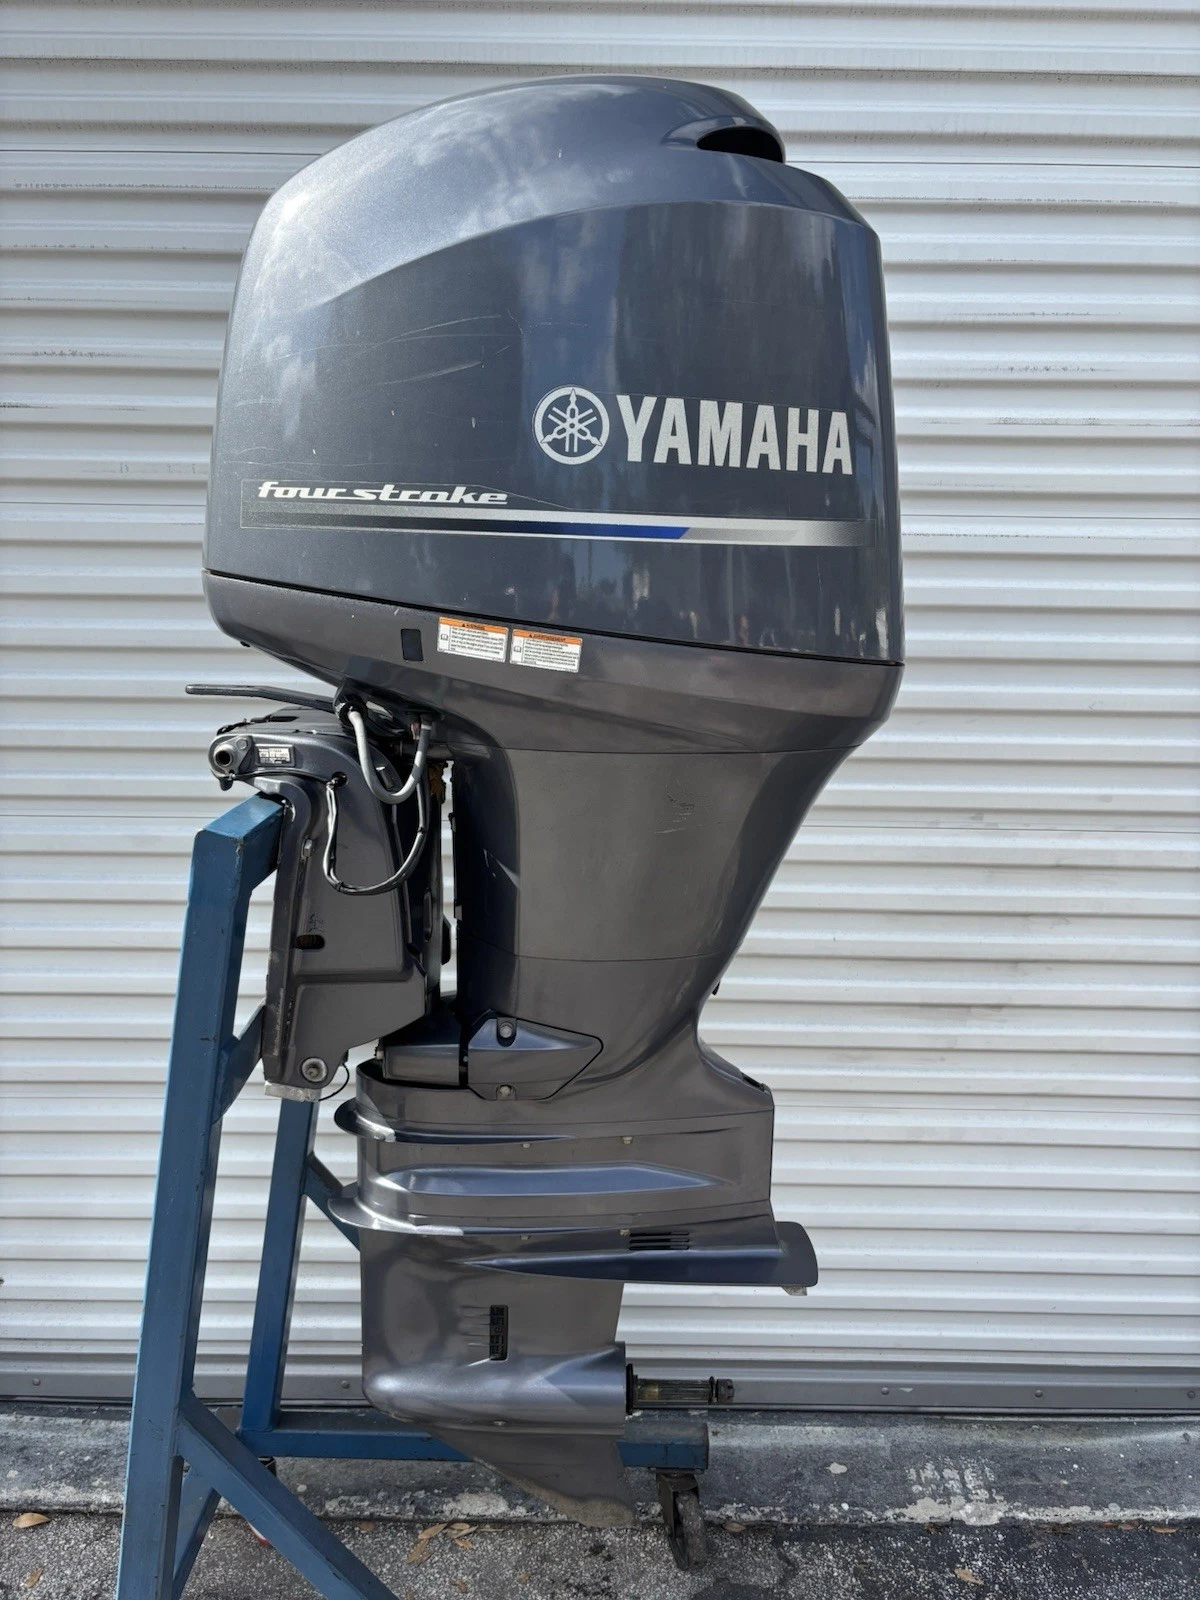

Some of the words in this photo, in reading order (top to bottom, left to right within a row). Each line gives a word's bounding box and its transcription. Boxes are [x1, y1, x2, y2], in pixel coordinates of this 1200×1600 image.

[616, 394, 853, 475] YAMAHA
[258, 481, 348, 499] four
[353, 484, 508, 505] stroke
